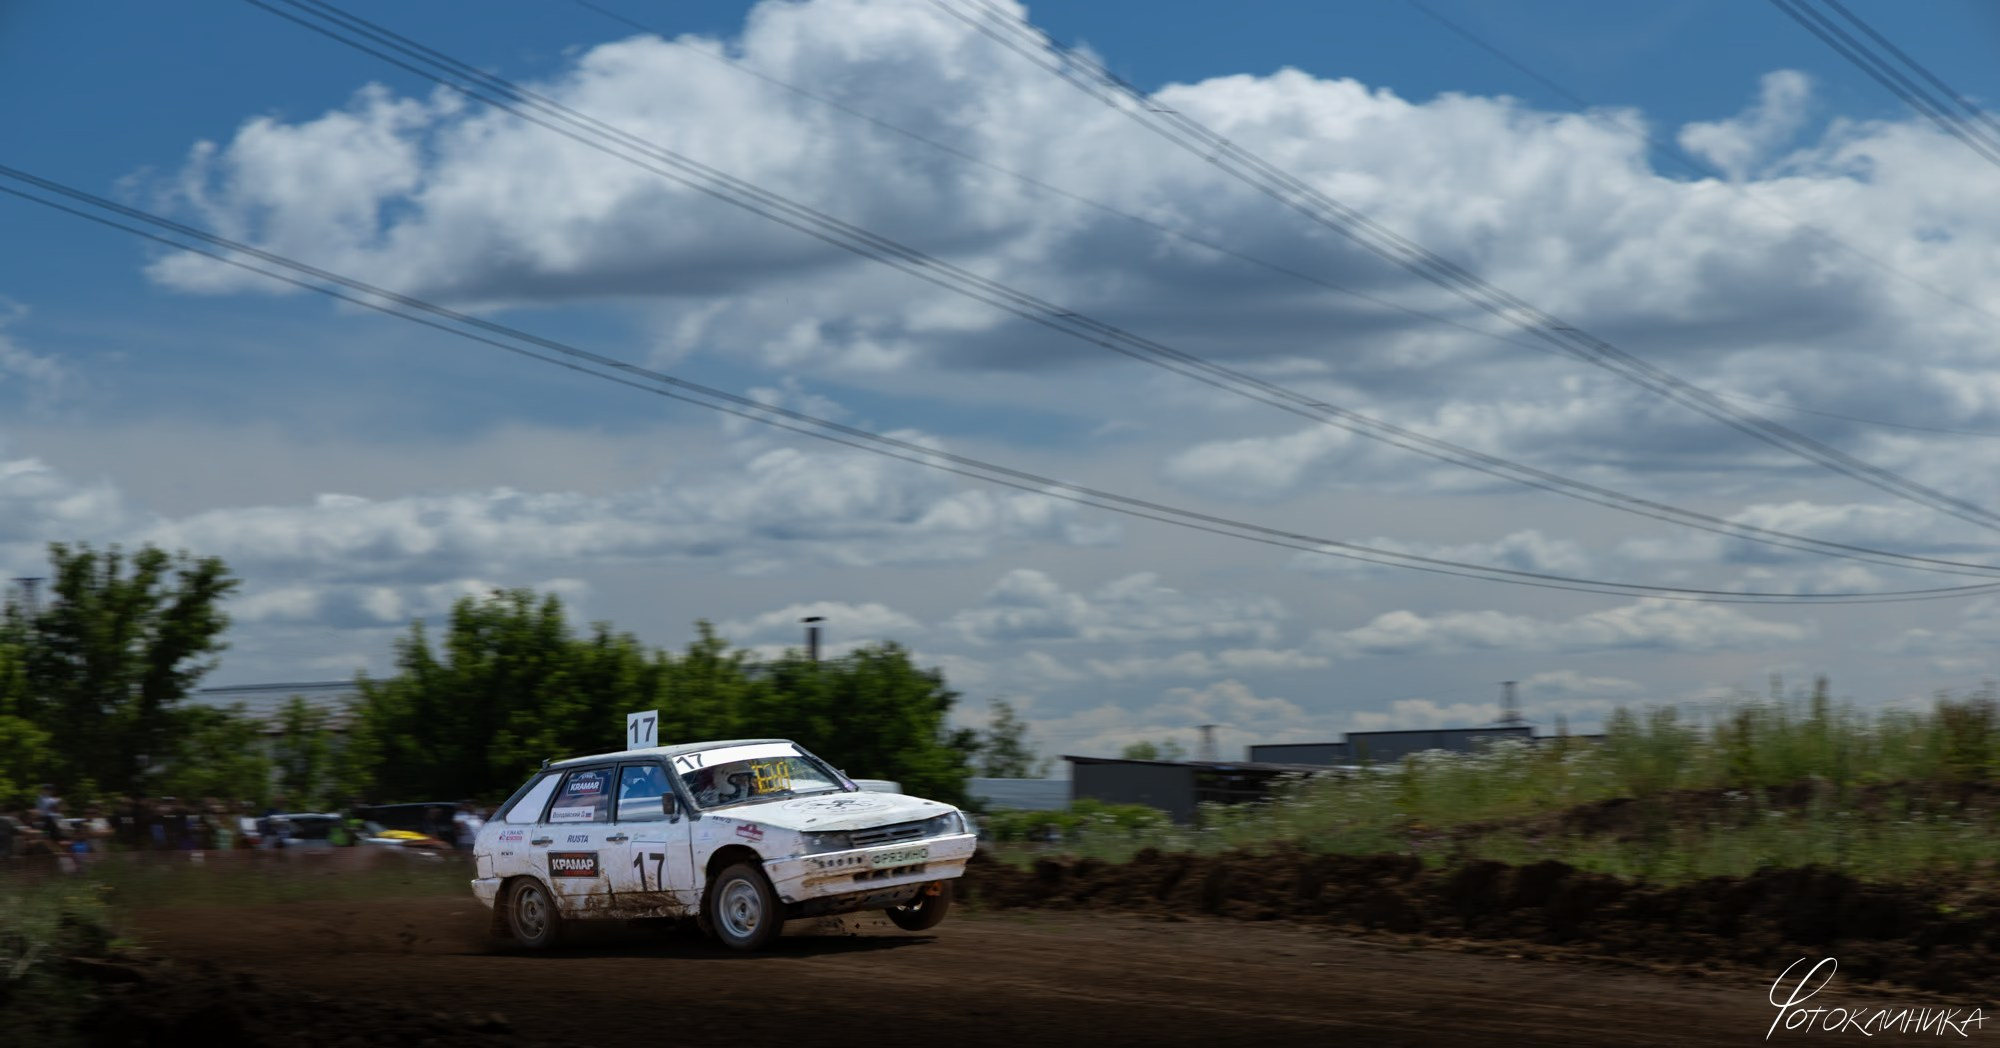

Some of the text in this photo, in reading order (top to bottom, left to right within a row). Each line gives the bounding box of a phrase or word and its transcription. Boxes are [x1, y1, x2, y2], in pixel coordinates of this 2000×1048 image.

[630, 717, 656, 743] 17
[676, 753, 704, 770] 17
[570, 782, 600, 792] KRAMAR
[567, 834, 589, 844] RUSTA
[552, 858, 595, 871] КРАМАР
[871, 848, 929, 865] ФРЯЗИНО
[633, 851, 665, 892] 17
